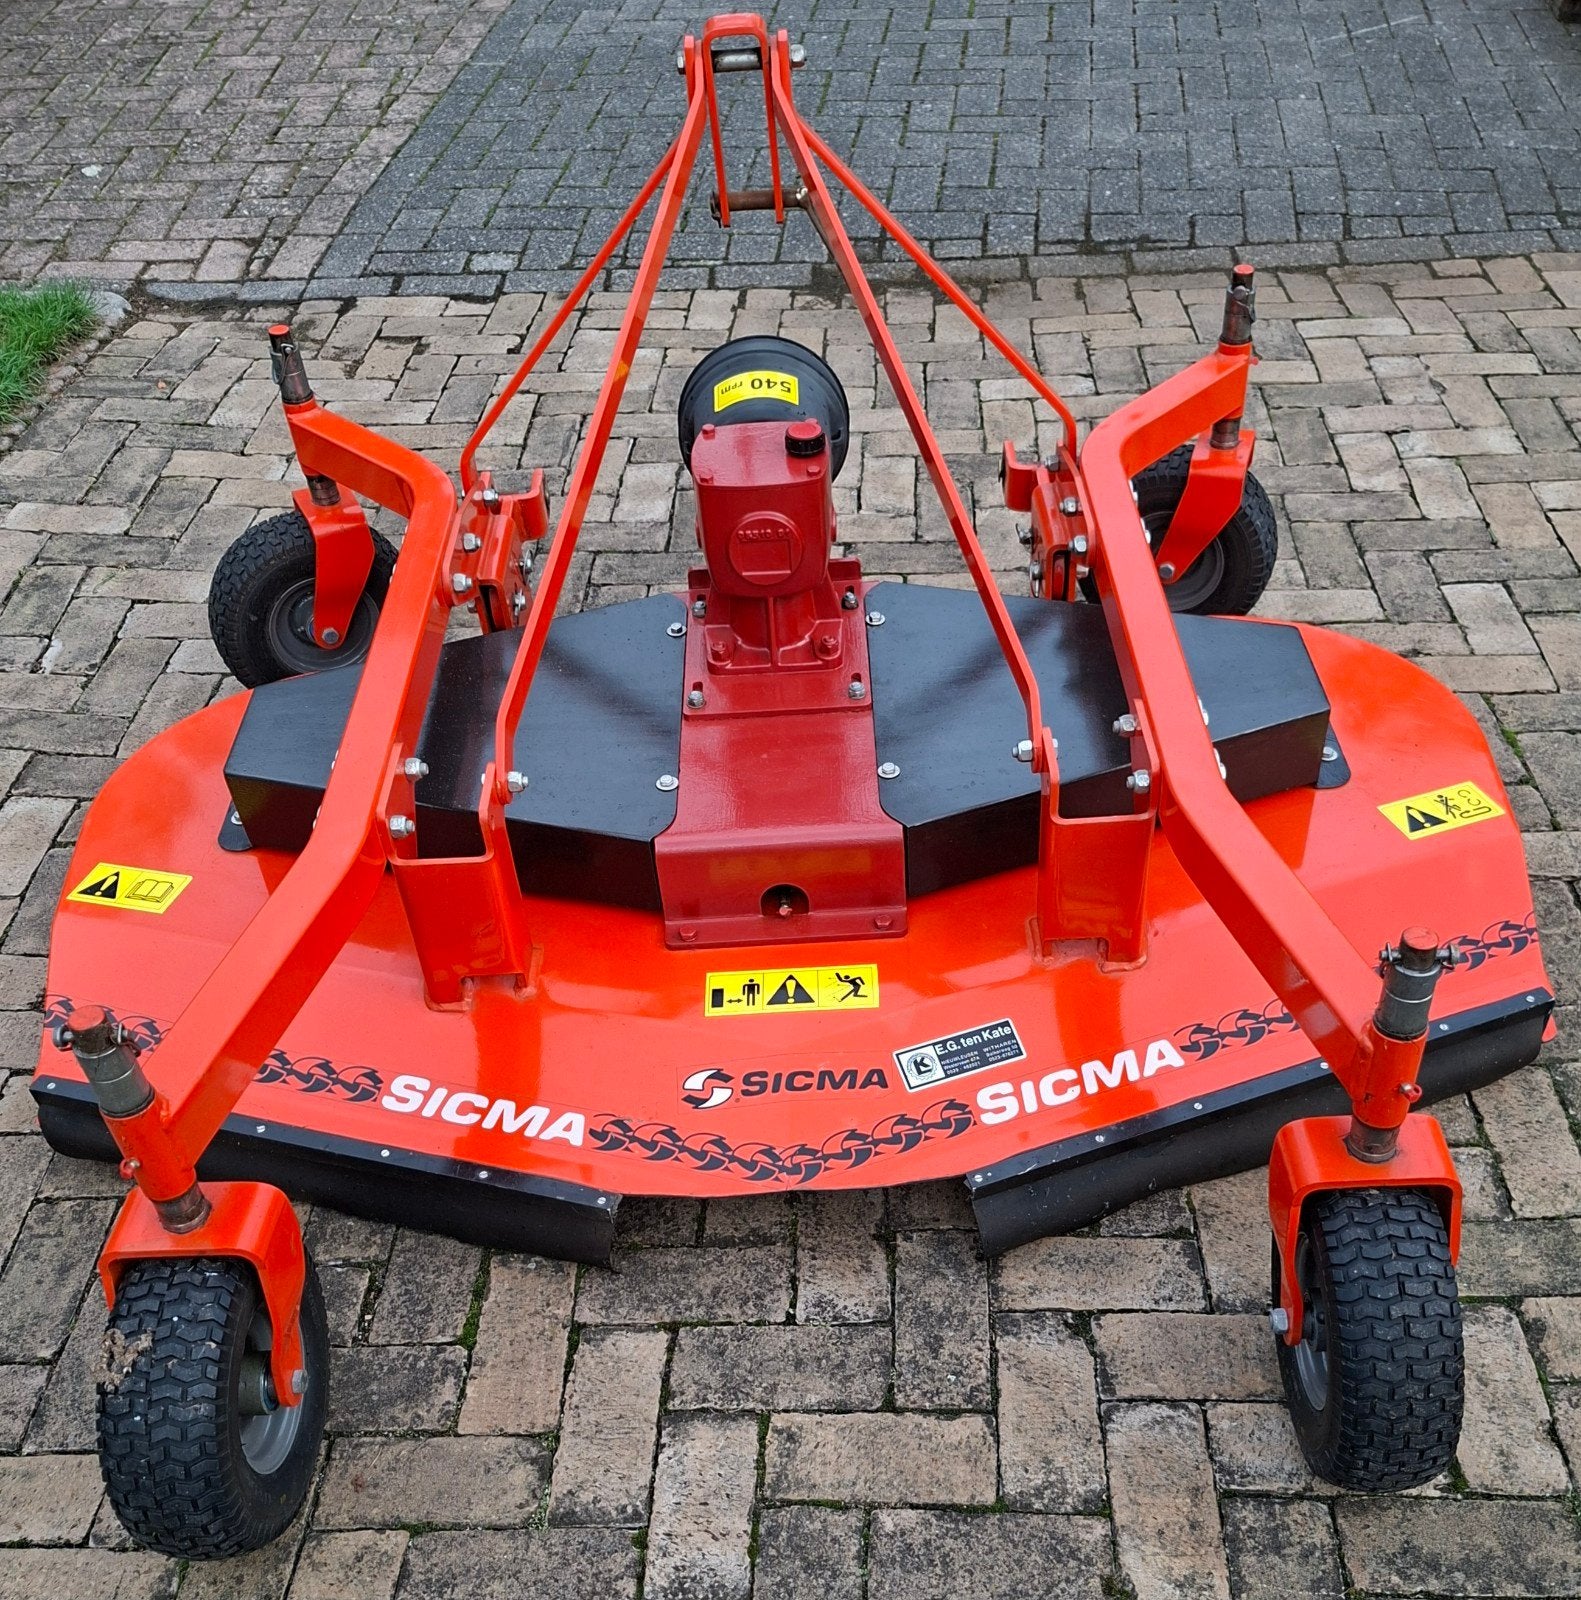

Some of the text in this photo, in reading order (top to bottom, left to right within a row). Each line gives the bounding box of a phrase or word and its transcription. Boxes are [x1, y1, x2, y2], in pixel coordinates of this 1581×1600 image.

[721, 378, 791, 394] 540 rpm
[934, 1025, 1012, 1056] E.G. ten Kate
[983, 1039, 1017, 1053] WITHAREN
[741, 1069, 889, 1097] SICMA
[976, 1039, 1185, 1125] SICMA
[381, 1074, 585, 1147] SICMA
